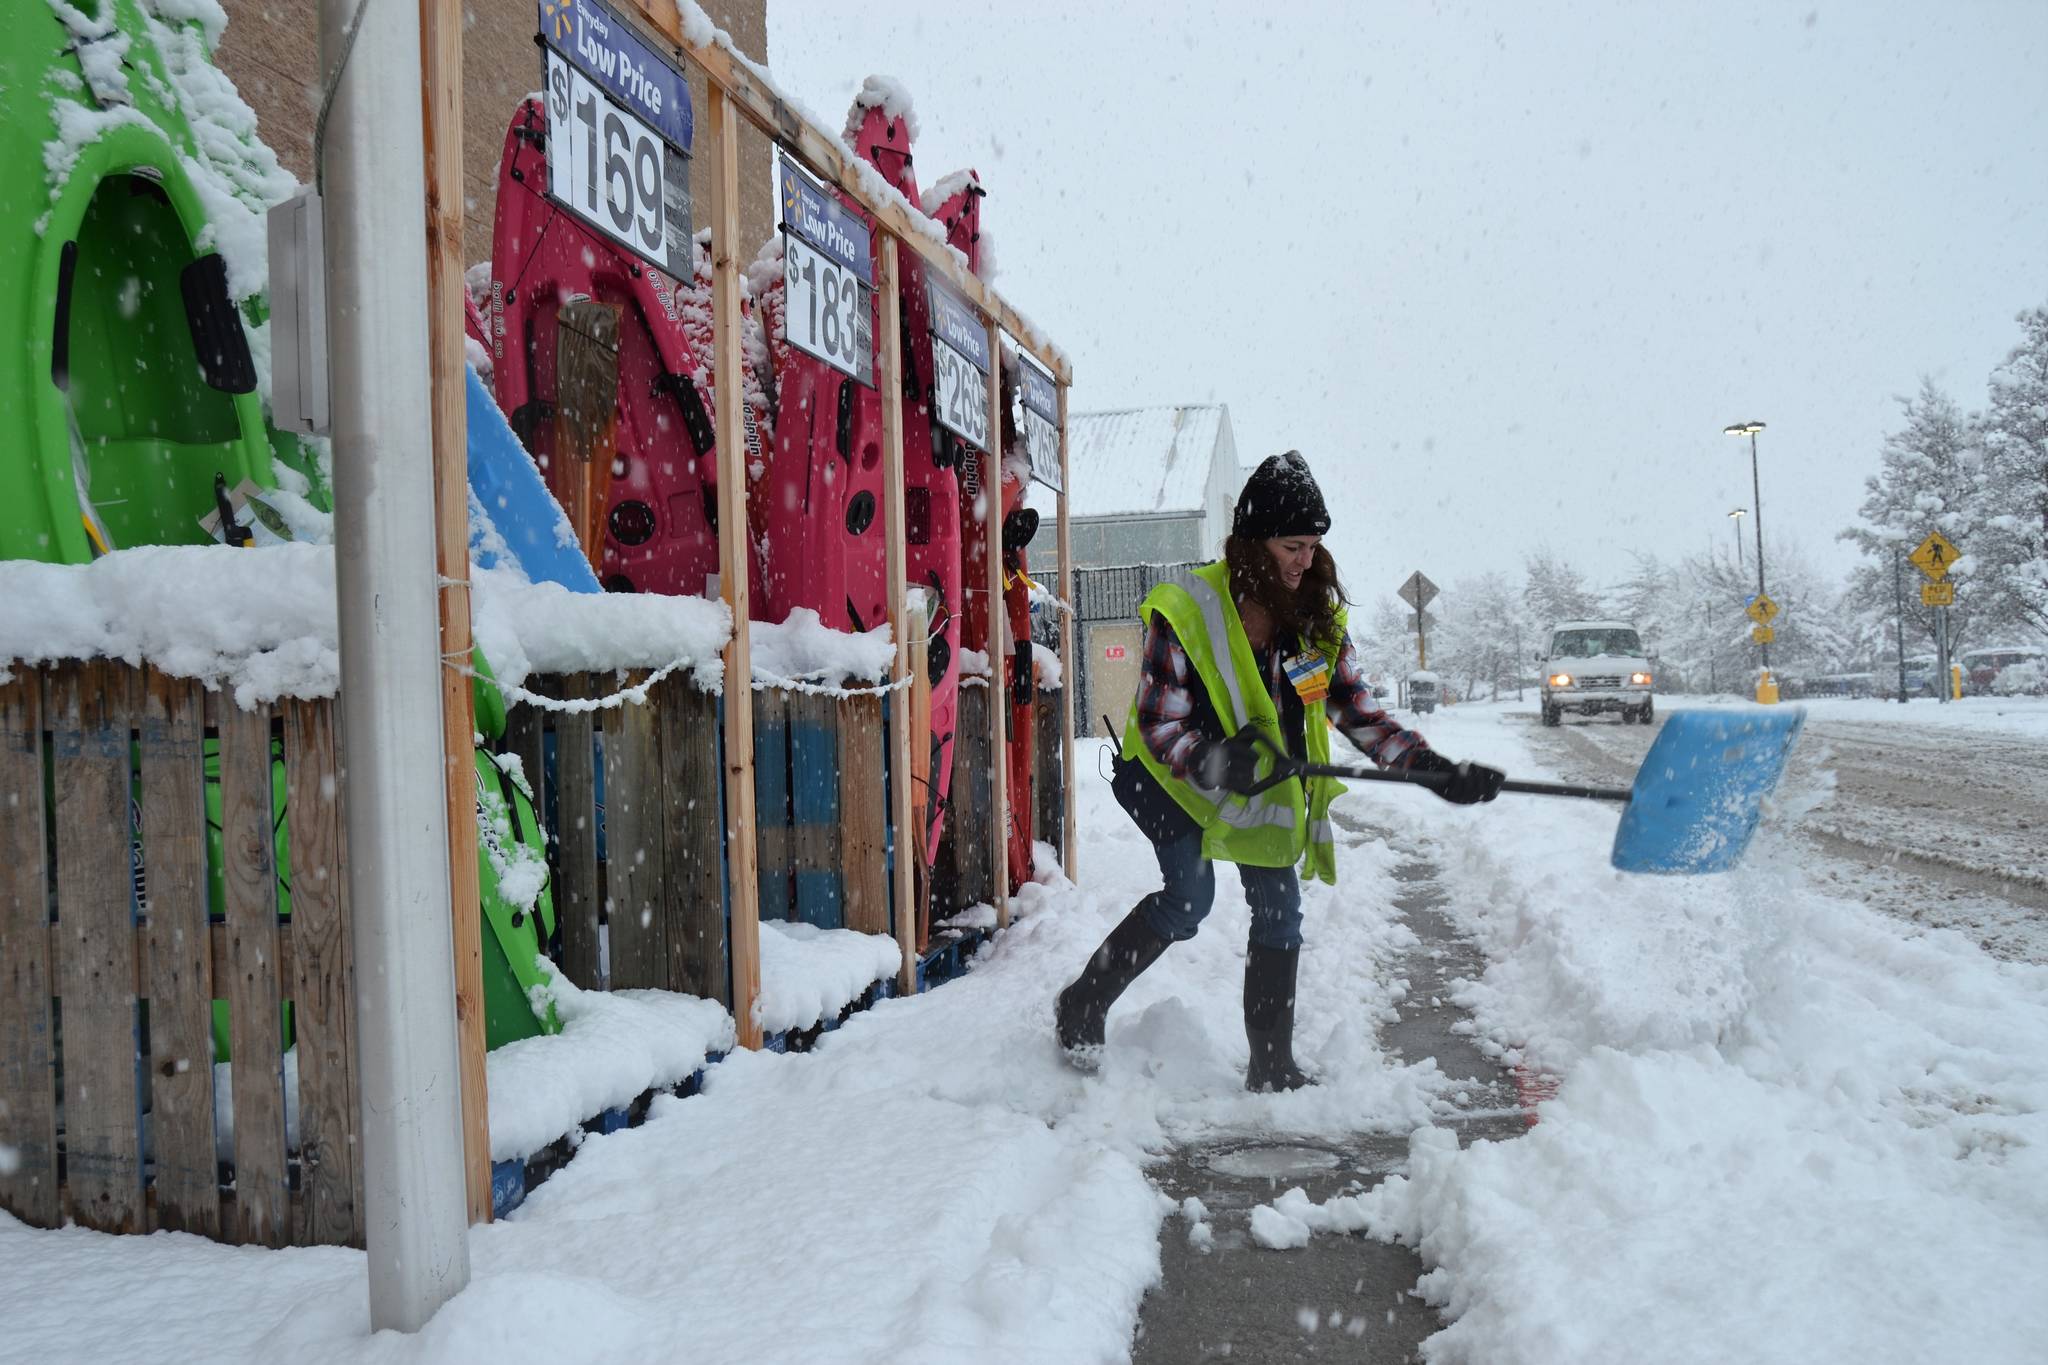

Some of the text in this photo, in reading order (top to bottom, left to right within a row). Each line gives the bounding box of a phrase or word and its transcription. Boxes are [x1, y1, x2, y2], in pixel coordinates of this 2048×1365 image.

[577, 0, 609, 39] Everyday
[577, 14, 662, 114] Low Price
[552, 64, 664, 251] $169
[802, 202, 855, 263] Low Price
[493, 281, 504, 312] bali
[656, 292, 678, 321] bali
[789, 243, 857, 364] $183
[947, 312, 963, 344] Low
[963, 326, 980, 357] Price
[743, 405, 763, 457] dolphin
